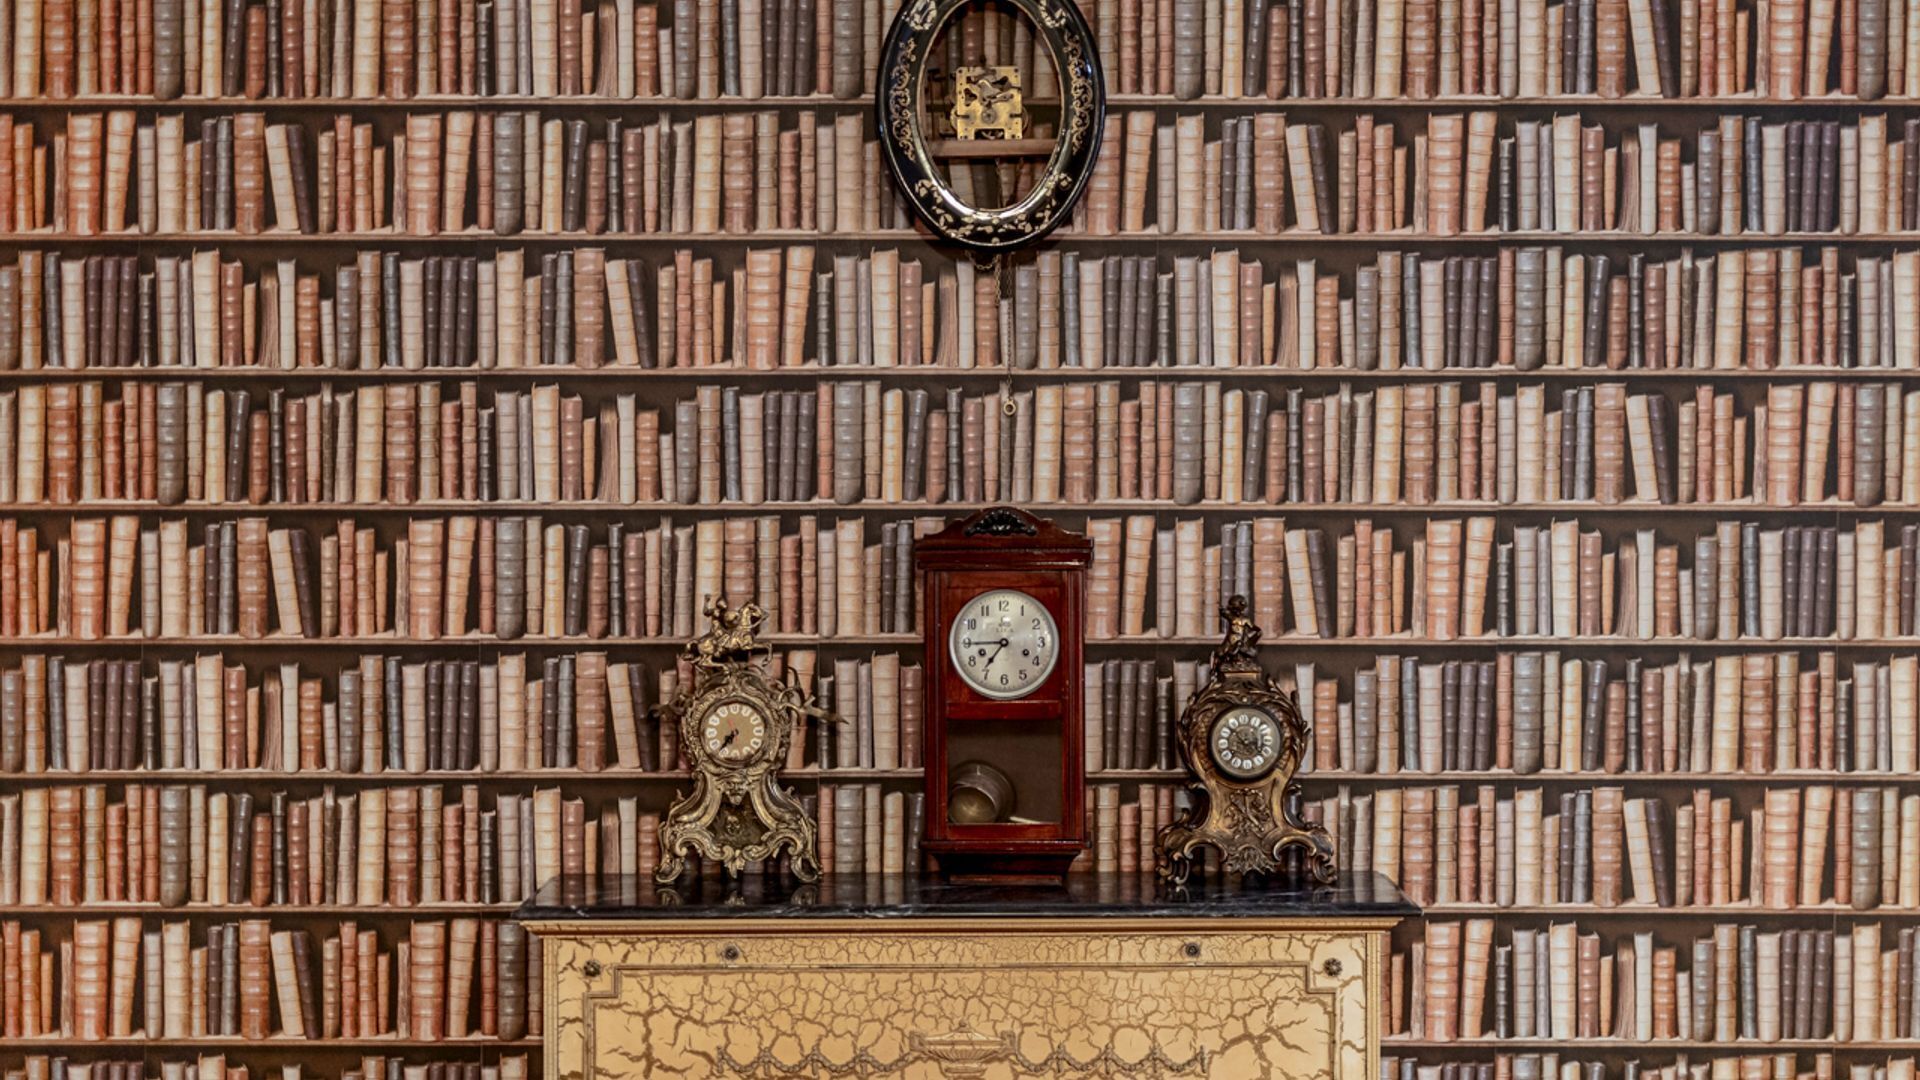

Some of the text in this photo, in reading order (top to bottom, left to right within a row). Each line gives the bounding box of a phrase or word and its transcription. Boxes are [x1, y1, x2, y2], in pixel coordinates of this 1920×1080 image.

[981, 605, 990, 616] 11
[999, 600, 1009, 612] 12
[1020, 605, 1024, 616] 1
[967, 619, 977, 630] 10
[1032, 618, 1041, 630] 2
[1037, 637, 1045, 648] 3
[968, 655, 976, 667] 8
[1032, 655, 1040, 667] 4
[982, 668, 990, 680] 7
[1000, 673, 1009, 685] 6
[1019, 669, 1027, 680] 5
